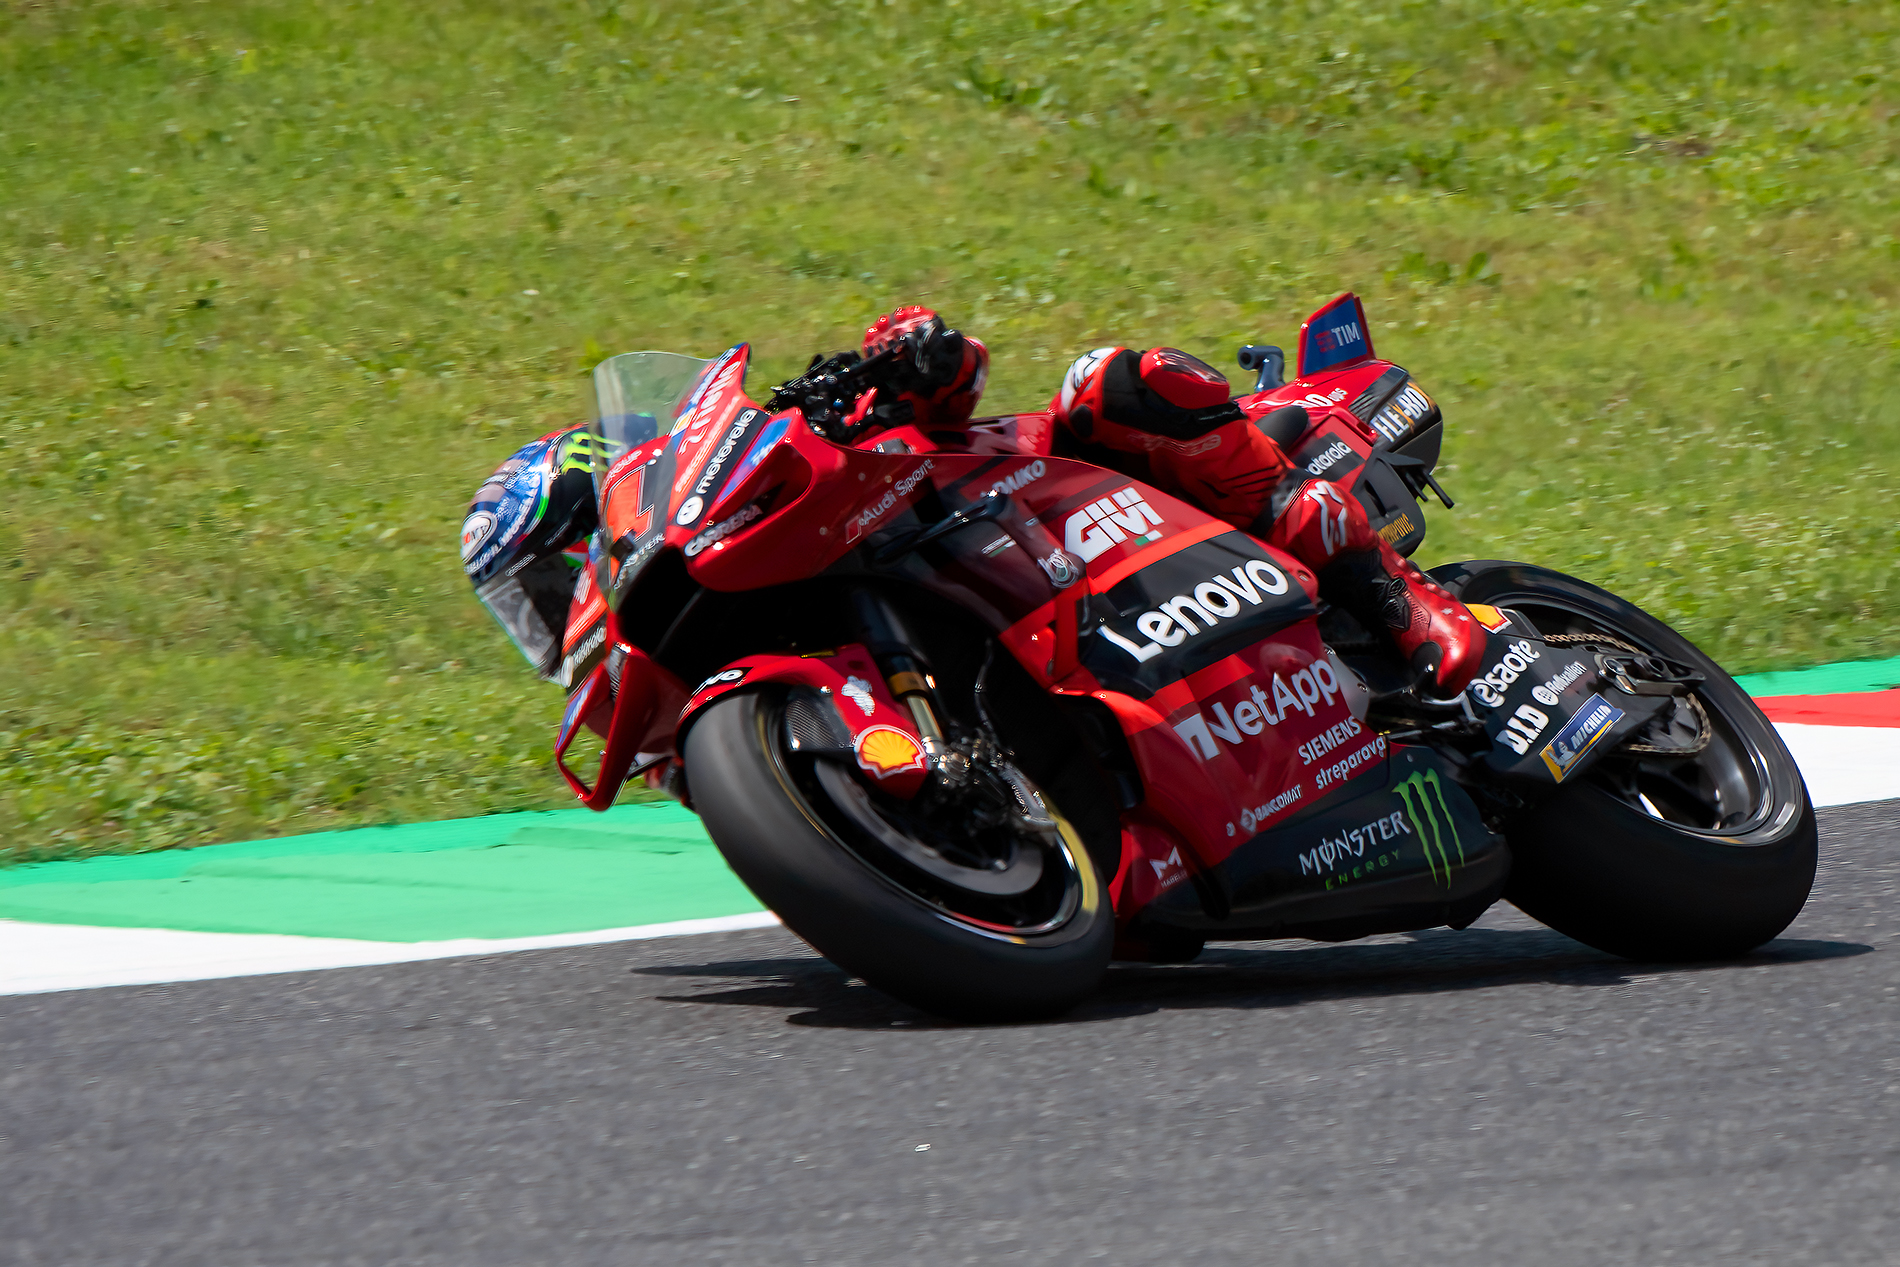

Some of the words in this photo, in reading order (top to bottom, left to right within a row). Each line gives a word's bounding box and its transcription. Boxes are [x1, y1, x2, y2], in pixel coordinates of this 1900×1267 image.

[1331, 321, 1361, 347] TIM
[695, 409, 758, 494] motorola
[1305, 441, 1352, 476] otorola
[861, 490, 897, 526] Audi
[894, 458, 935, 496] Sport
[1065, 486, 1164, 564] GIVI
[1096, 559, 1289, 663] Lenovo
[1206, 658, 1340, 745] NetApp
[1298, 715, 1362, 766] SIEMENS
[1315, 735, 1386, 790] streparava
[1298, 810, 1411, 876] MONSTER
[1325, 849, 1399, 891] ENERGY
